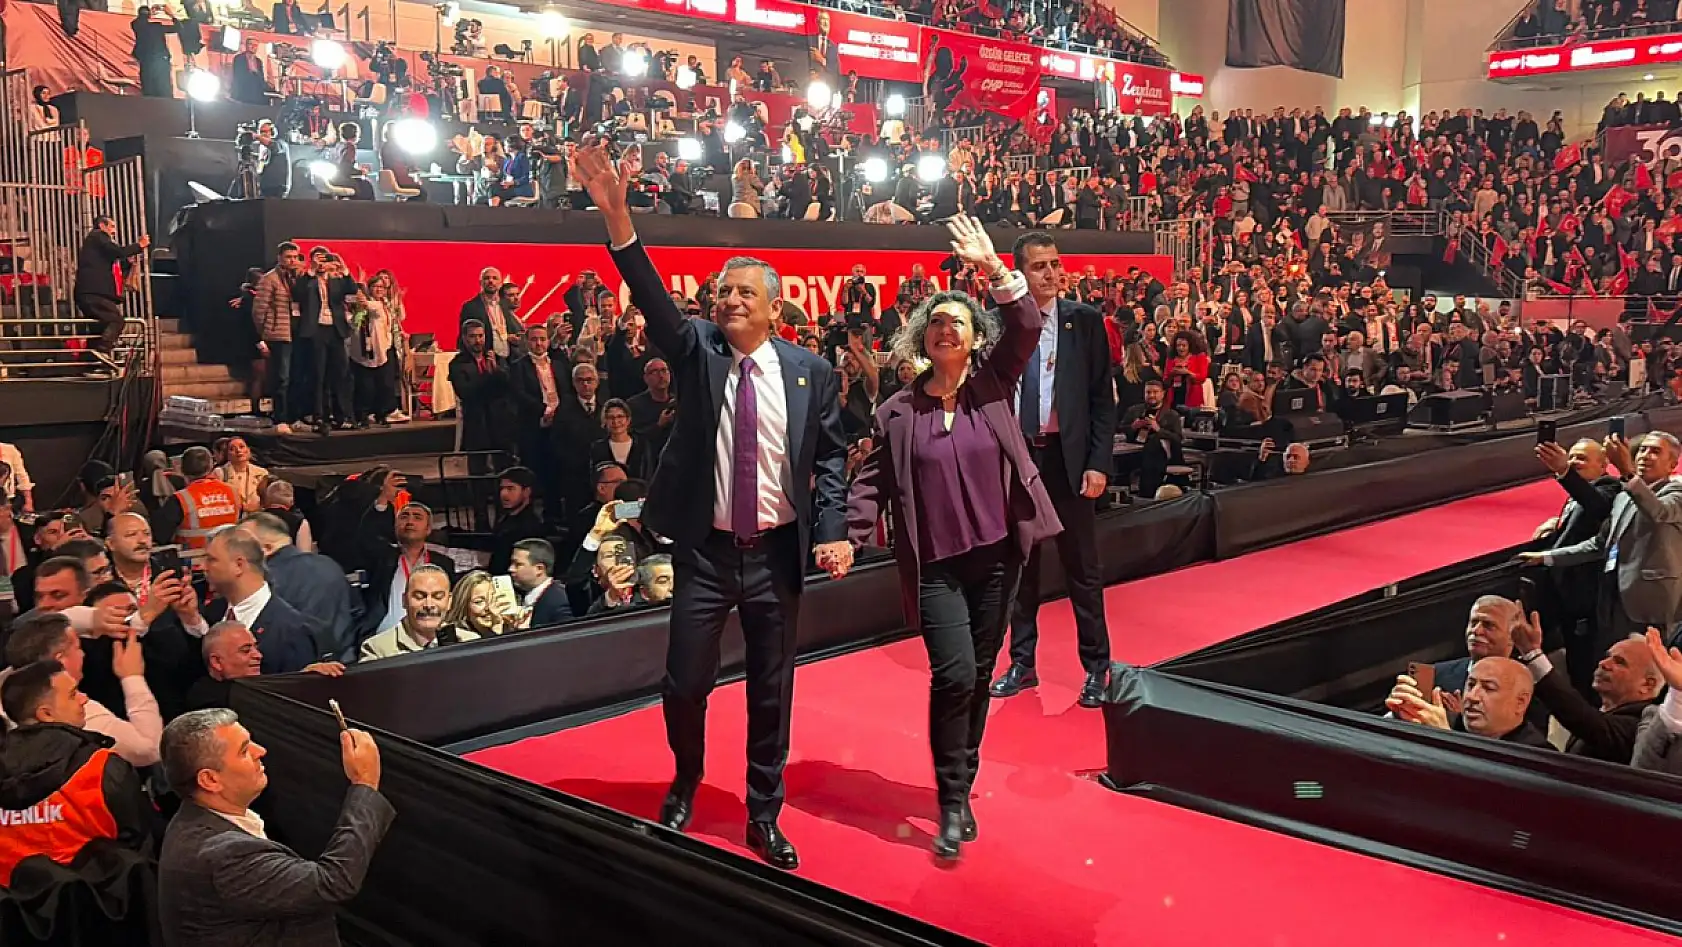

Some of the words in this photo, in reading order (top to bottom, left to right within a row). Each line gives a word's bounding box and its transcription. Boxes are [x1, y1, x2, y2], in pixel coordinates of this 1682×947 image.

[981, 79, 1003, 92] CHP
[1122, 73, 1163, 105] Zeydan
[201, 493, 228, 504] ÖZEL
